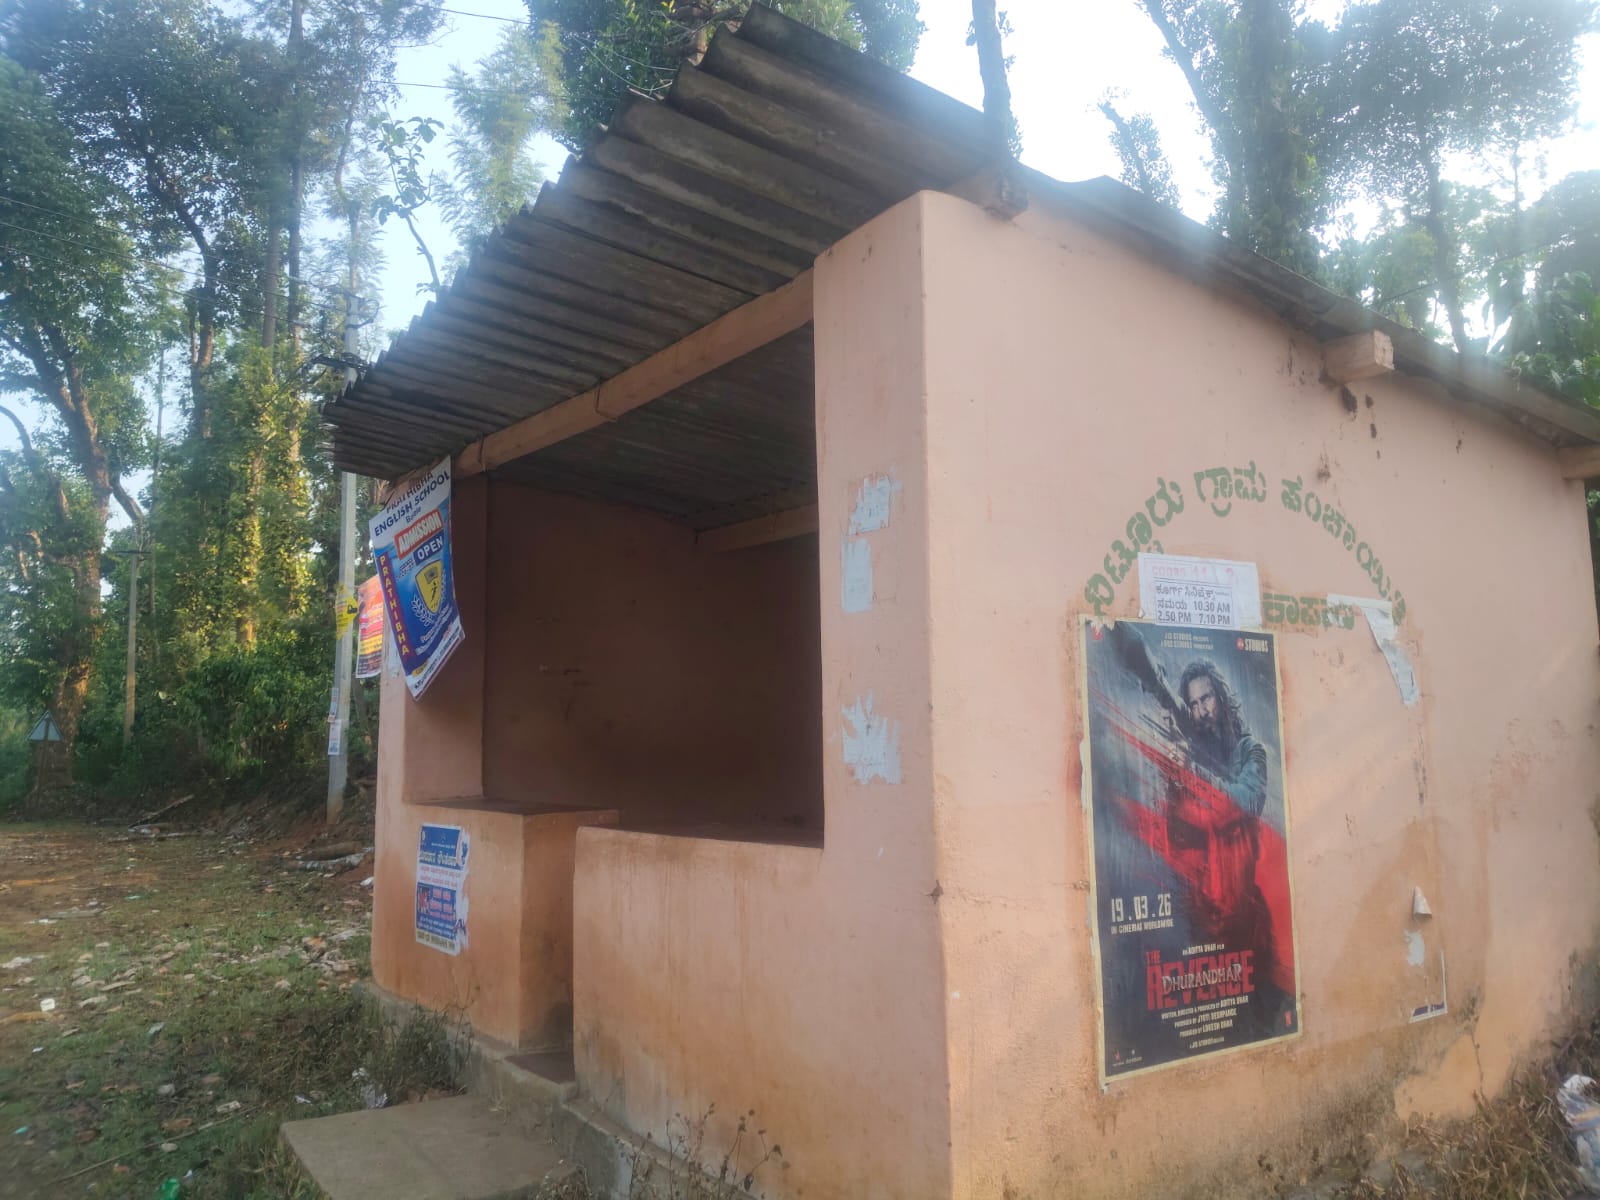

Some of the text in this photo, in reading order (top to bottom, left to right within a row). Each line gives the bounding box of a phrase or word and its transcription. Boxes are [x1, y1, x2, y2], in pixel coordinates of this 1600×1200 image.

[374, 470, 450, 537] ENGLISH SCHOOL
[1193, 460, 1267, 517] ಗ್ರಾಮ
[398, 511, 442, 554] ADMISSION
[417, 536, 443, 561] OPEN
[380, 555, 410, 656] PRATHIBHA
[1158, 610, 1231, 625] 2.50 PM 7.10 PM
[1193, 600, 1215, 613] 10.30
[1217, 602, 1230, 613] AM
[1146, 950, 1161, 965] THE
[1162, 963, 1243, 994] DHURANDHAR
